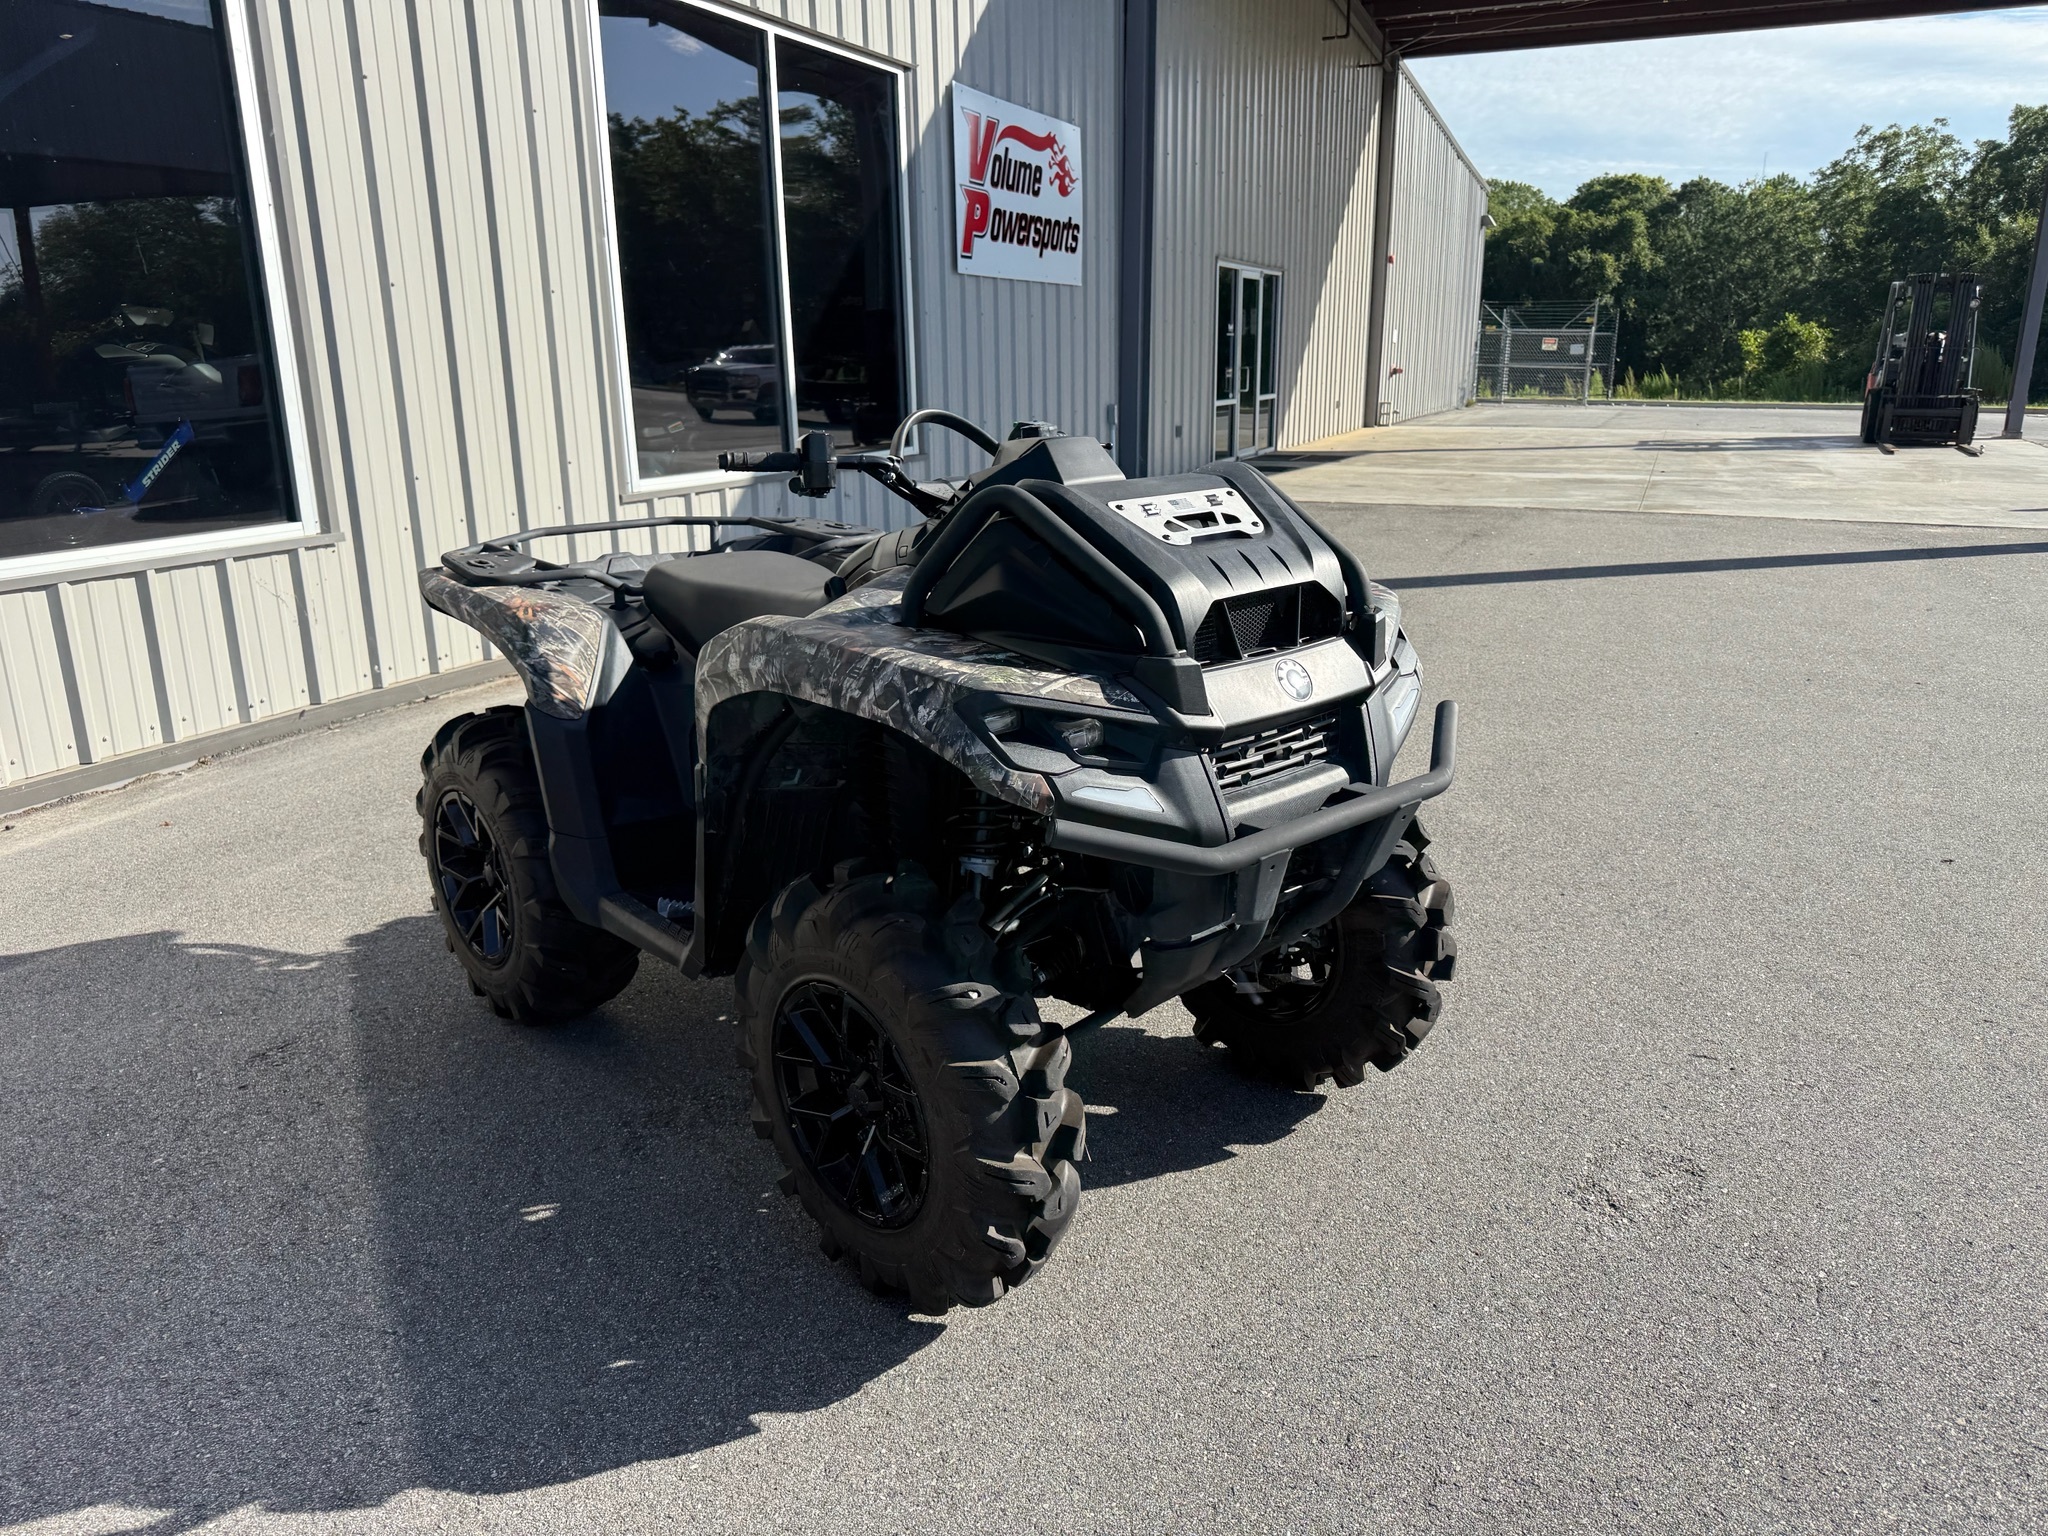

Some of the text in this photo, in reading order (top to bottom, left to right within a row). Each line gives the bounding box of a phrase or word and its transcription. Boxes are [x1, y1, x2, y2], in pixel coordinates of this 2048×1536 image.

[960, 106, 1042, 198] Volume
[959, 183, 1080, 259] Powersports
[141, 439, 181, 488] STRIDER
